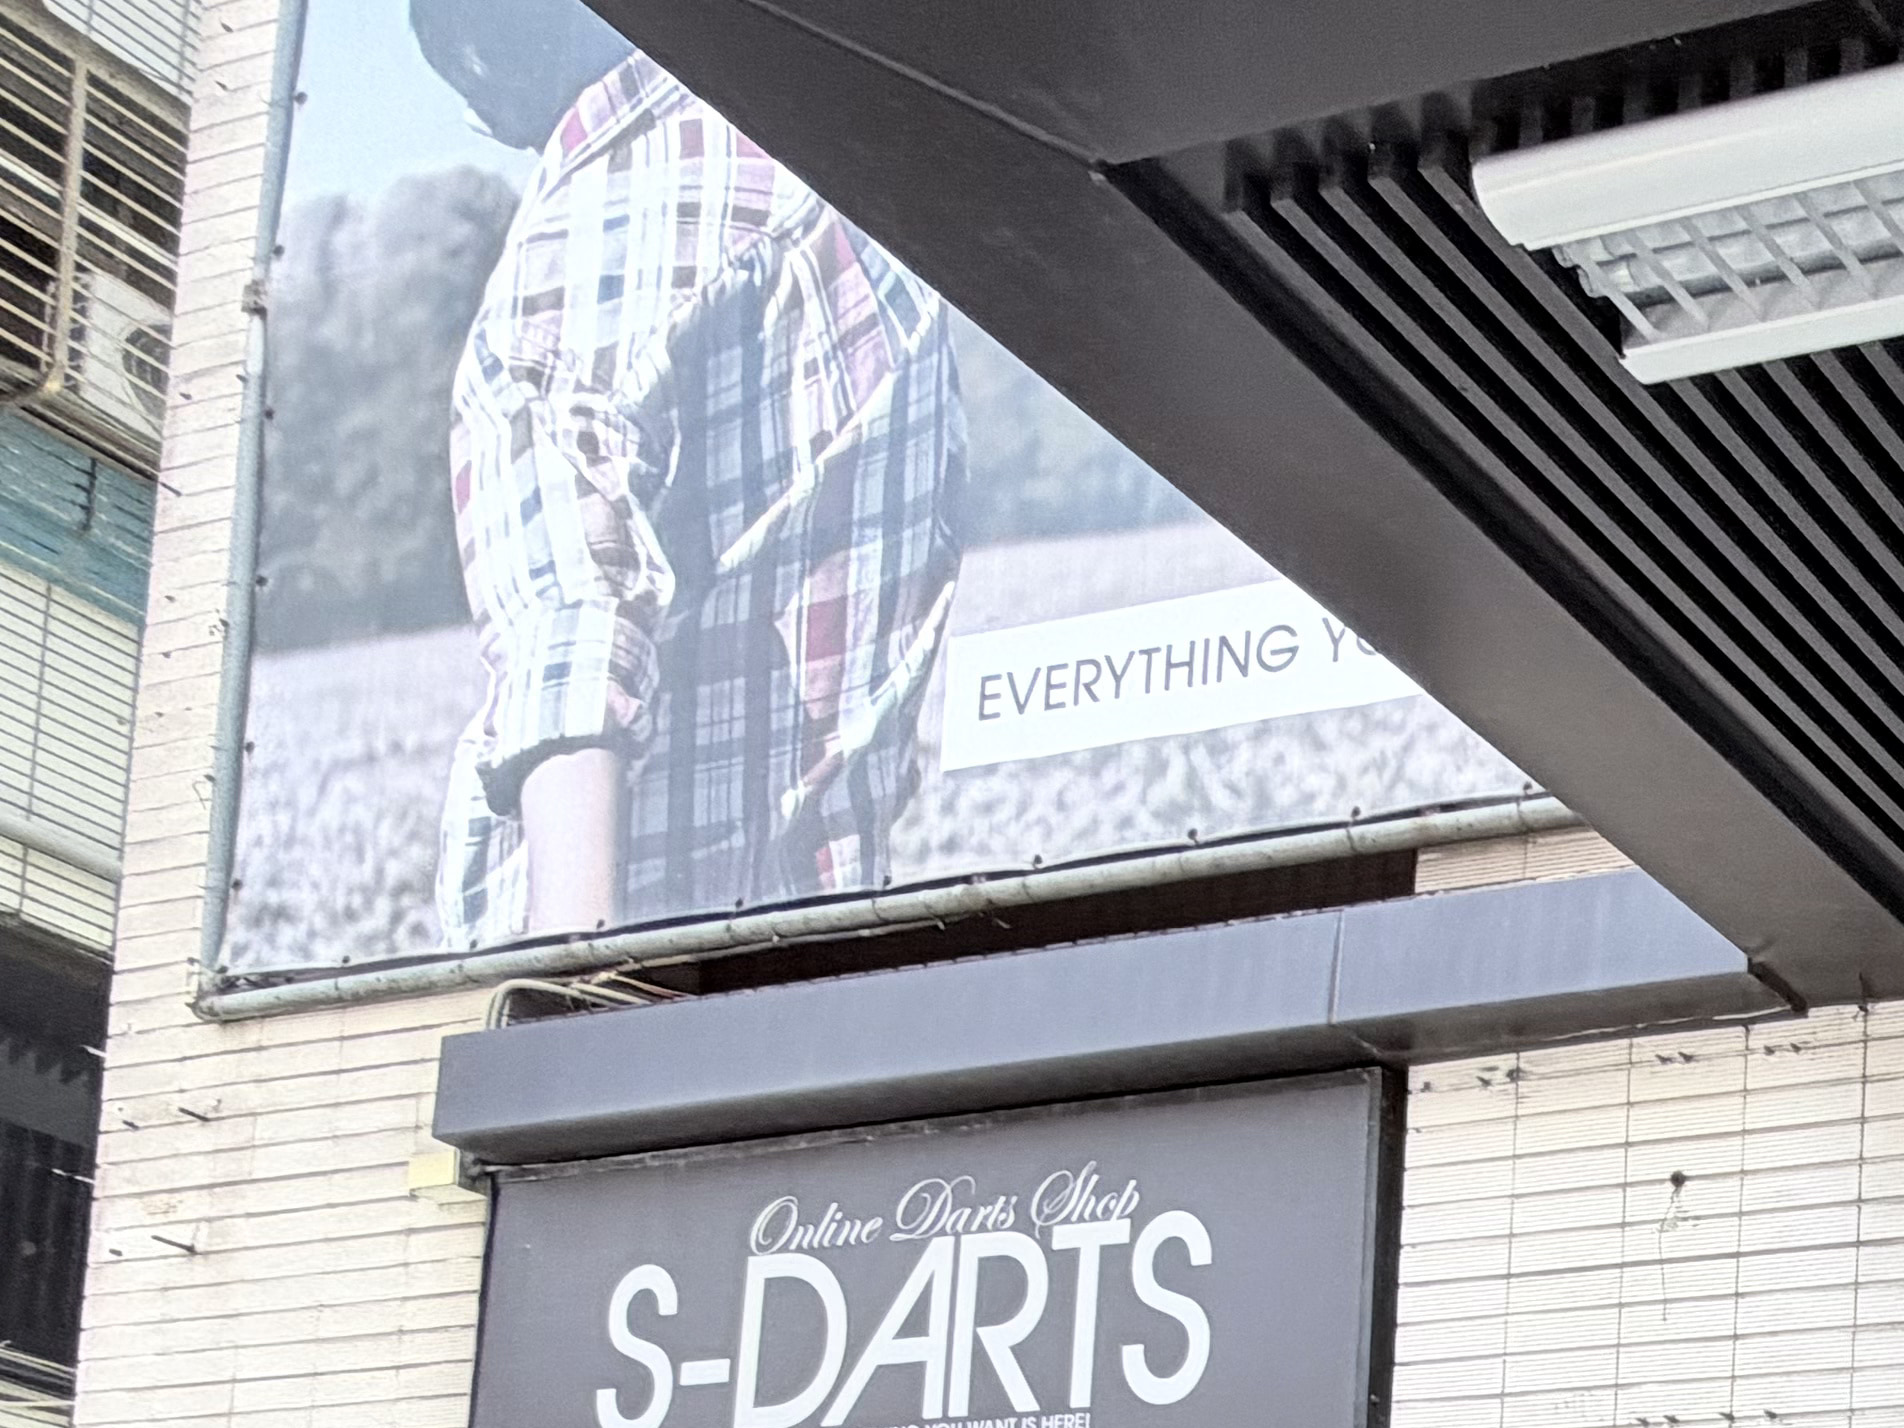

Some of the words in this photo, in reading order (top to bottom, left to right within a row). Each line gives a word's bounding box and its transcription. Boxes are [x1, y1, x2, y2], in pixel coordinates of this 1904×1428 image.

[978, 624, 1299, 721] EVERYTHING
[1321, 617, 1379, 662] Y
[748, 1195, 883, 1255] Online
[889, 1175, 1016, 1242] Darts
[1030, 1160, 1140, 1238] Shop
